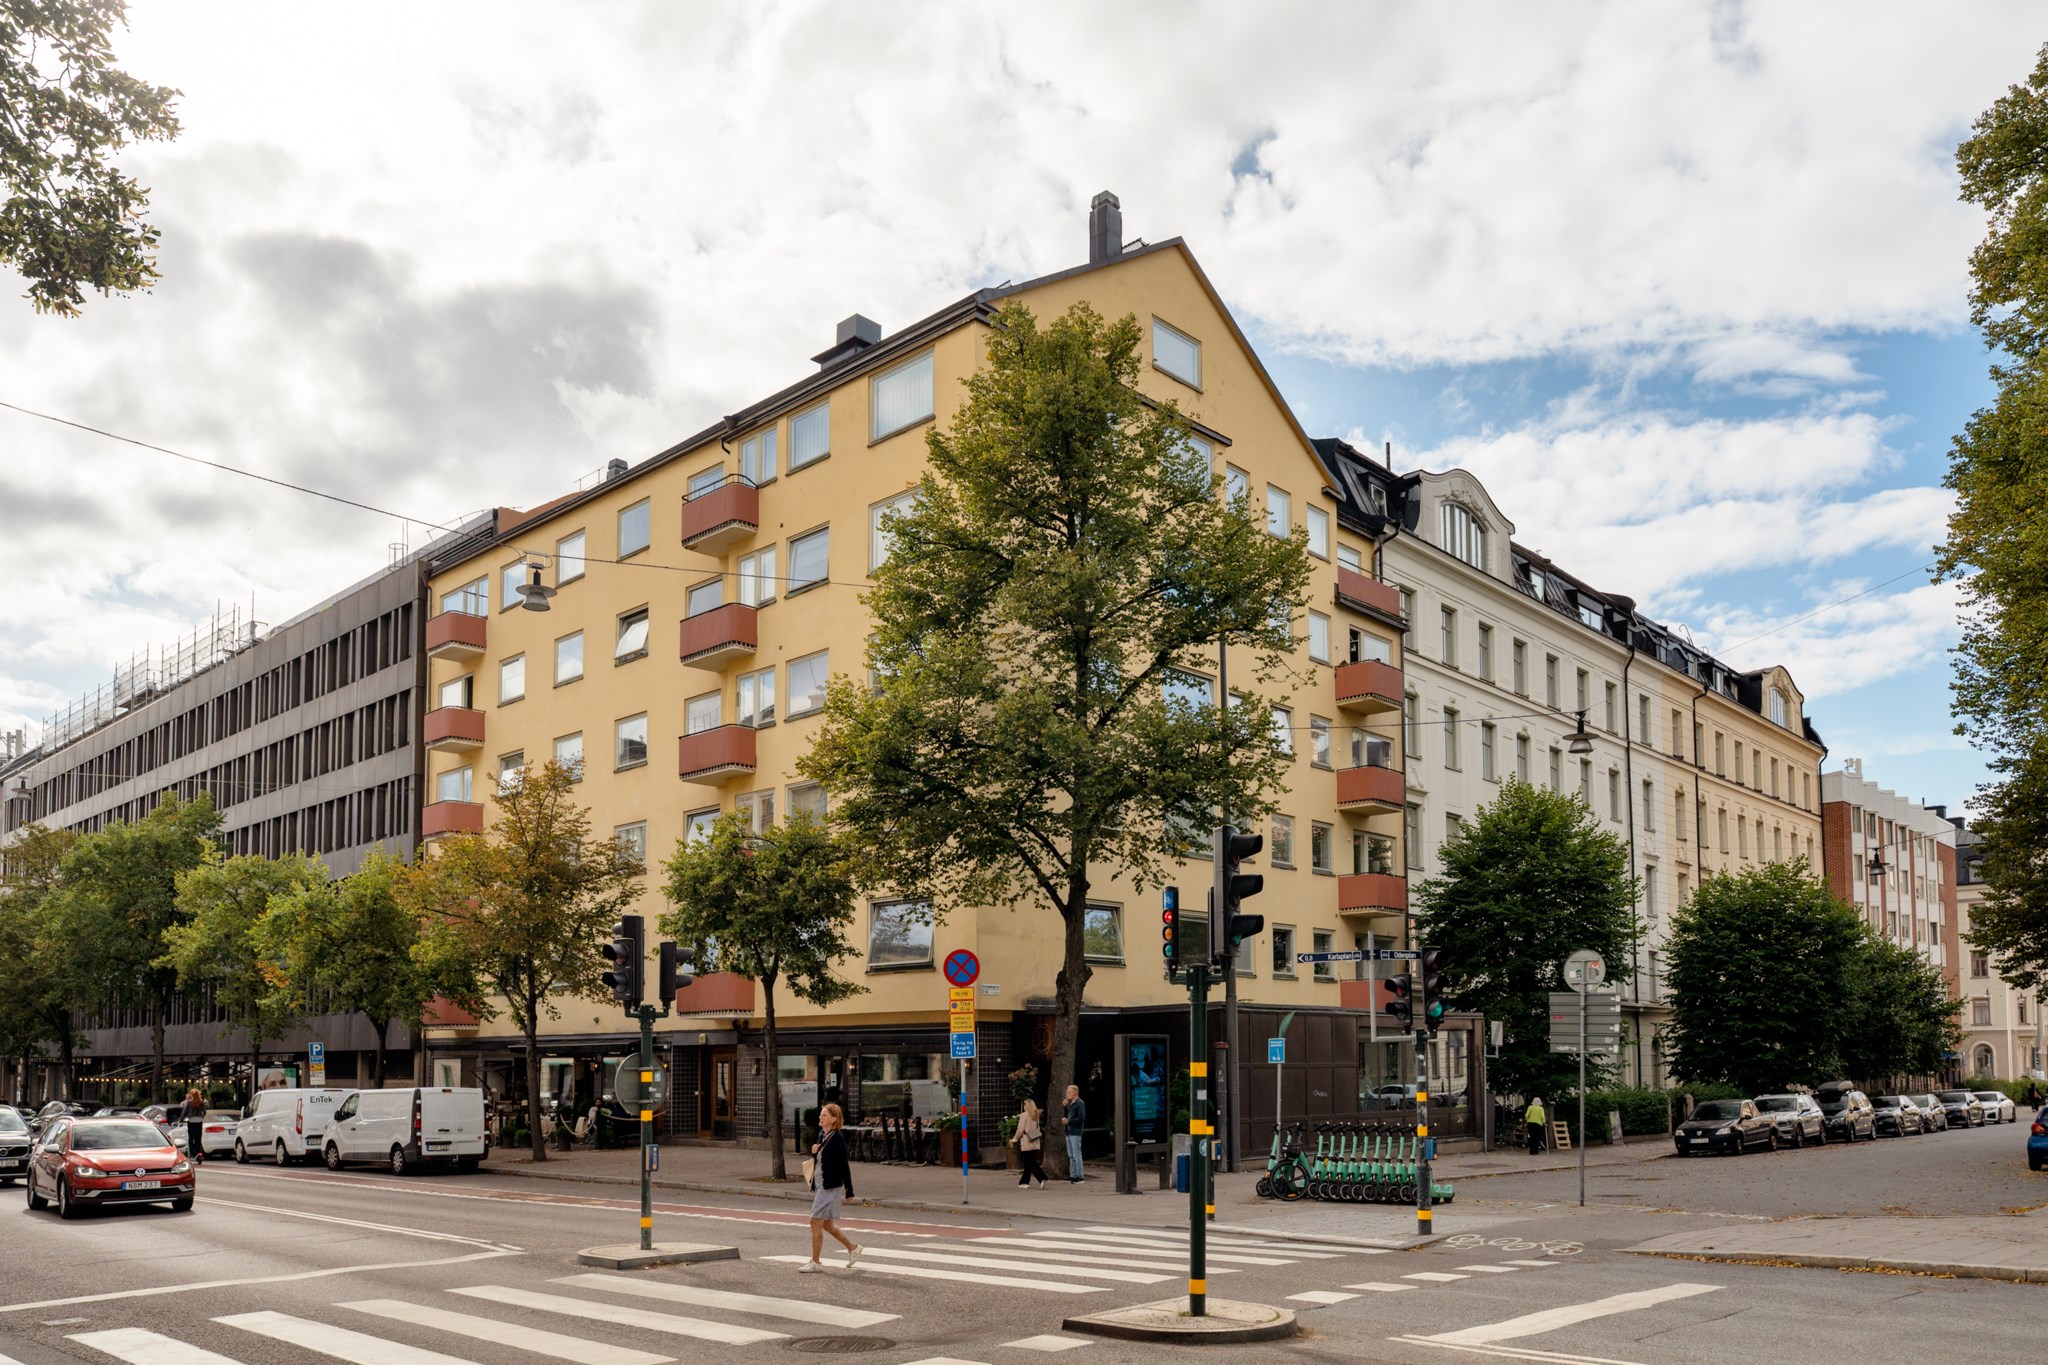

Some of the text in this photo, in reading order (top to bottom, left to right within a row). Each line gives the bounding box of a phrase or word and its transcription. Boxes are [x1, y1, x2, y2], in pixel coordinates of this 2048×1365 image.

[1328, 953, 1352, 961] Karlaplan
[1394, 952, 1416, 960] Odenplan
[312, 1044, 322, 1056] P
[310, 1096, 333, 1104] EnTek
